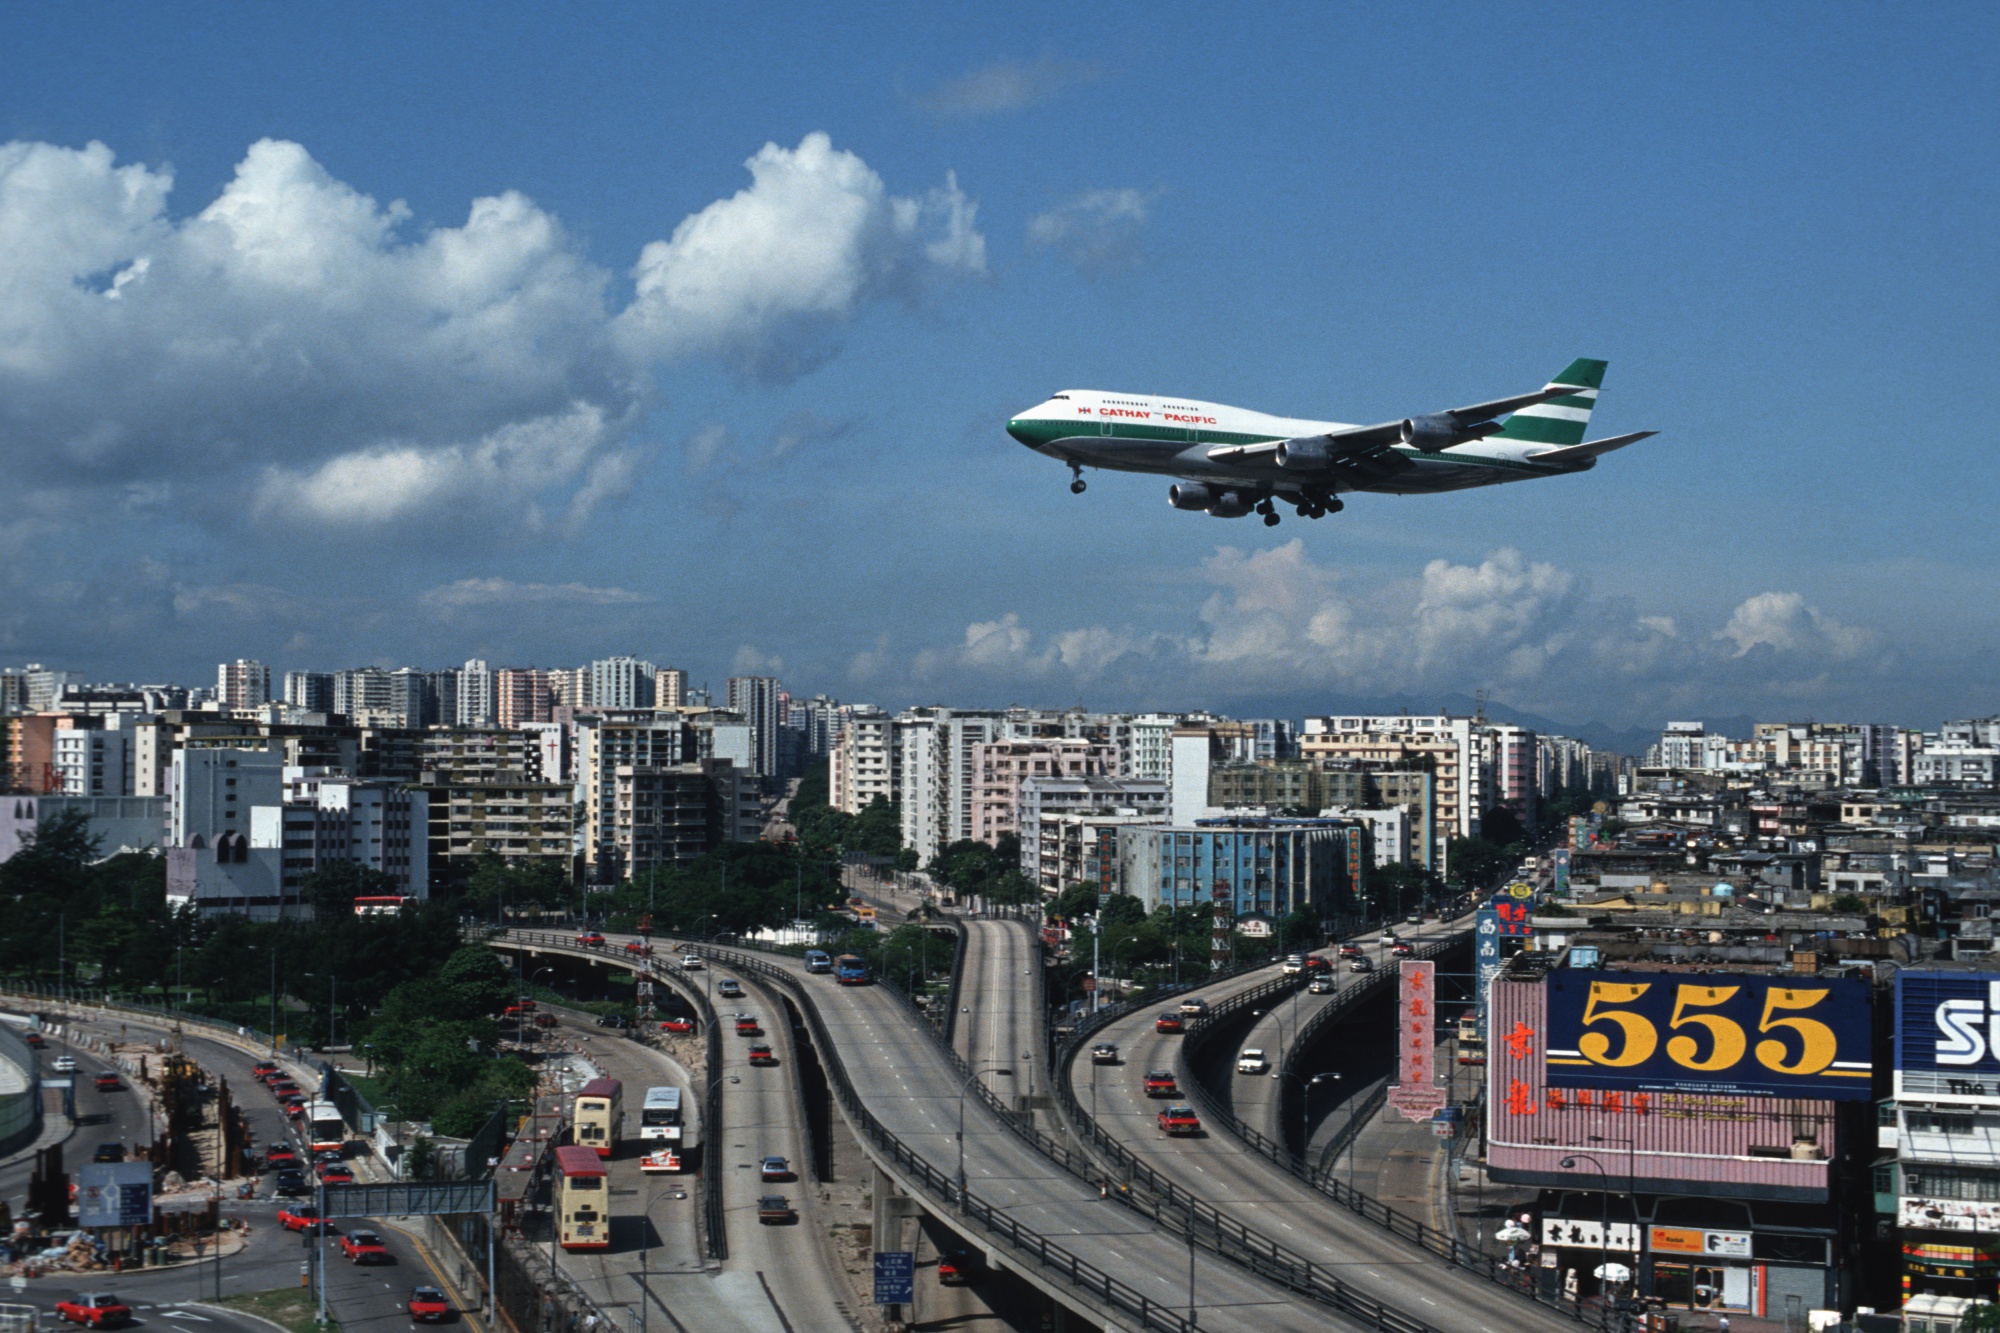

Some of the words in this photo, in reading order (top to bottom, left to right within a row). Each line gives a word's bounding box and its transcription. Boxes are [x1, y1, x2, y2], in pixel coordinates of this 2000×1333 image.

[1099, 408, 1150, 419] CATHAY
[1164, 413, 1217, 425] PACIFIC
[1578, 981, 1838, 1076] 555
[1946, 1079, 1985, 1095] The
